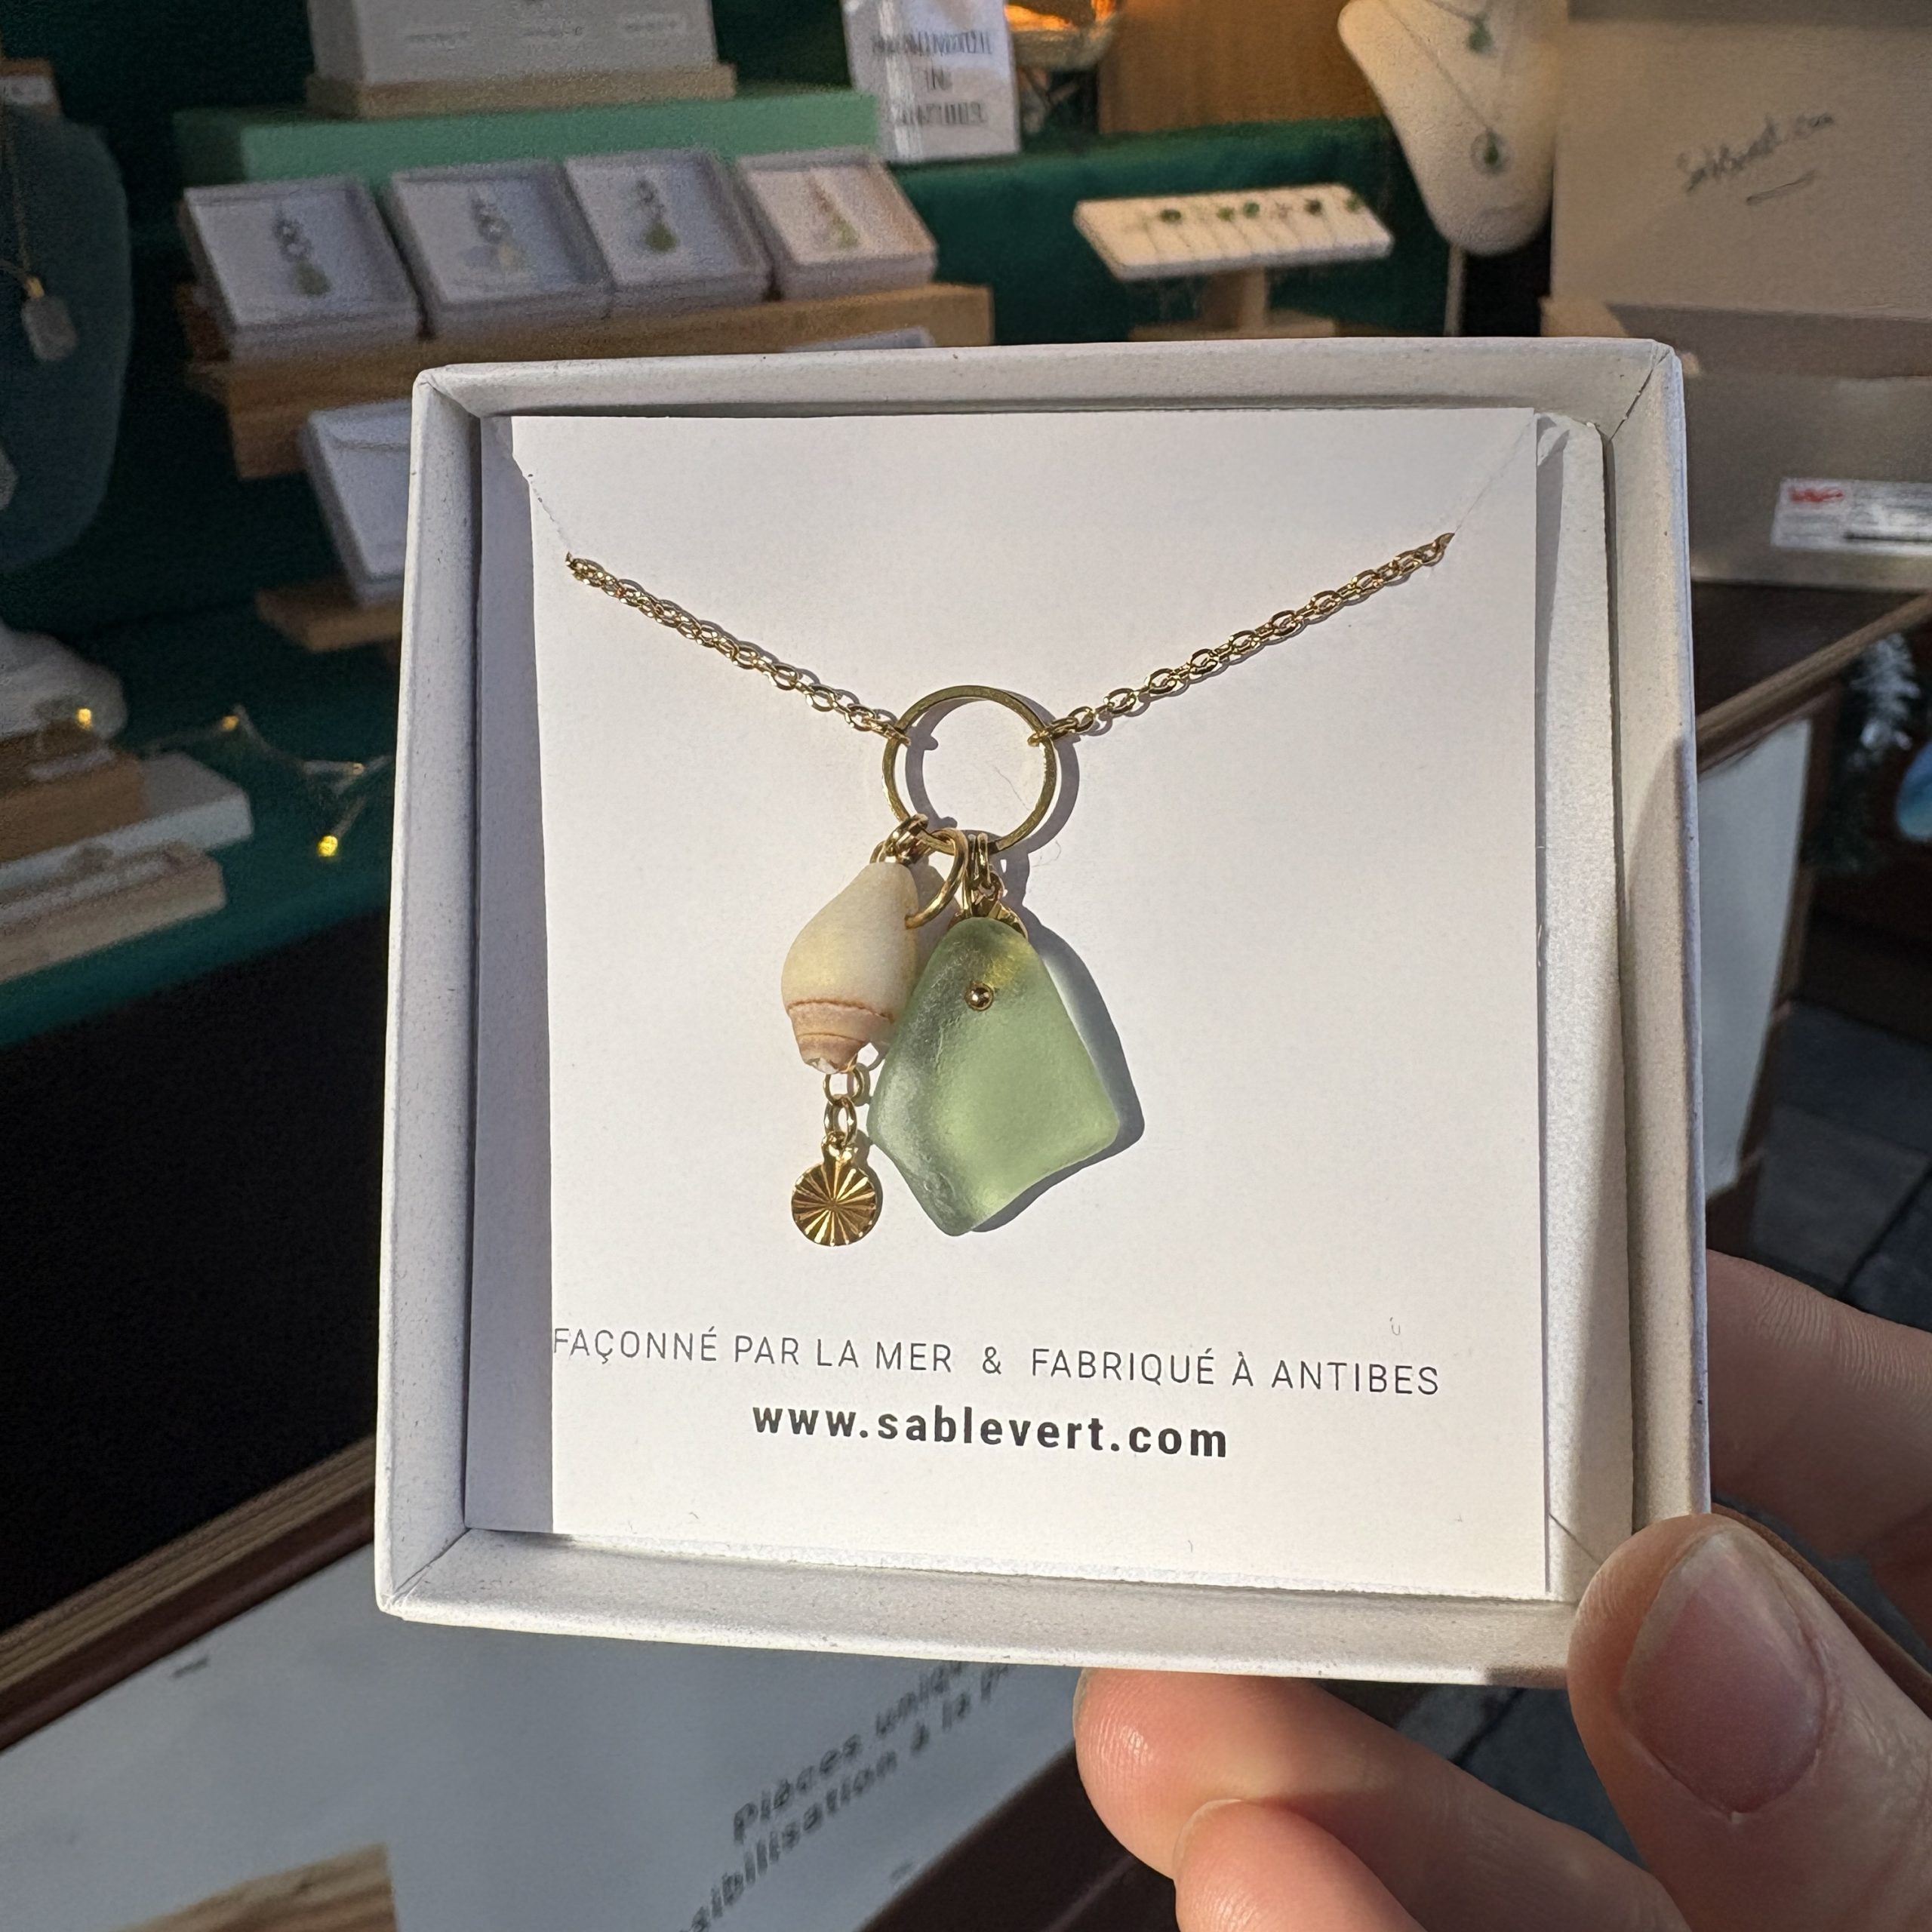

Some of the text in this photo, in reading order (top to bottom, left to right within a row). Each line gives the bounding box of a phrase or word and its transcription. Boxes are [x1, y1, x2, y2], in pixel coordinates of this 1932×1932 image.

[553, 1325, 1438, 1395] FAÇONNÉ PAR LA MER & FABRIQUÉ À ANTIBES
[752, 1404, 1227, 1458] www.sablevert.com
[679, 1749, 898, 1932] sibilisation
